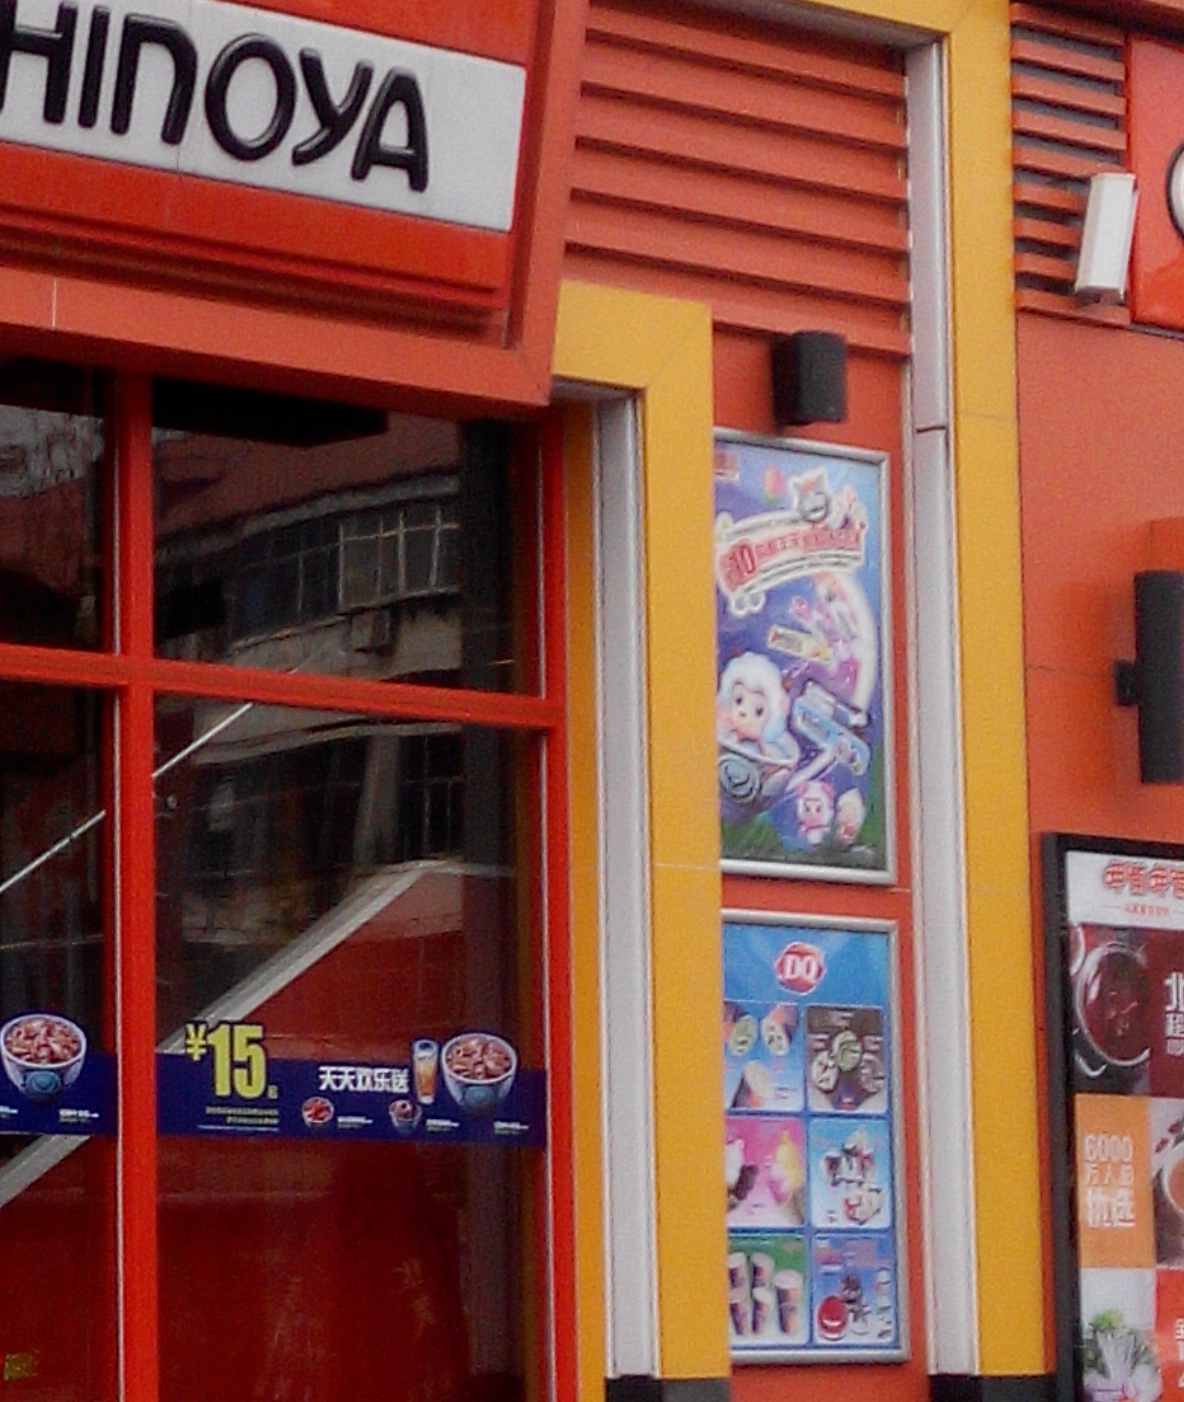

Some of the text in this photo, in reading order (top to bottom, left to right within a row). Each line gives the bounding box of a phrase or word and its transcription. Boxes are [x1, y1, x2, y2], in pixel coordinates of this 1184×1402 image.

[784, 954, 818, 982] DQ
[186, 1024, 266, 1098] ¥15
[318, 1066, 411, 1093] 天天欢乐送
